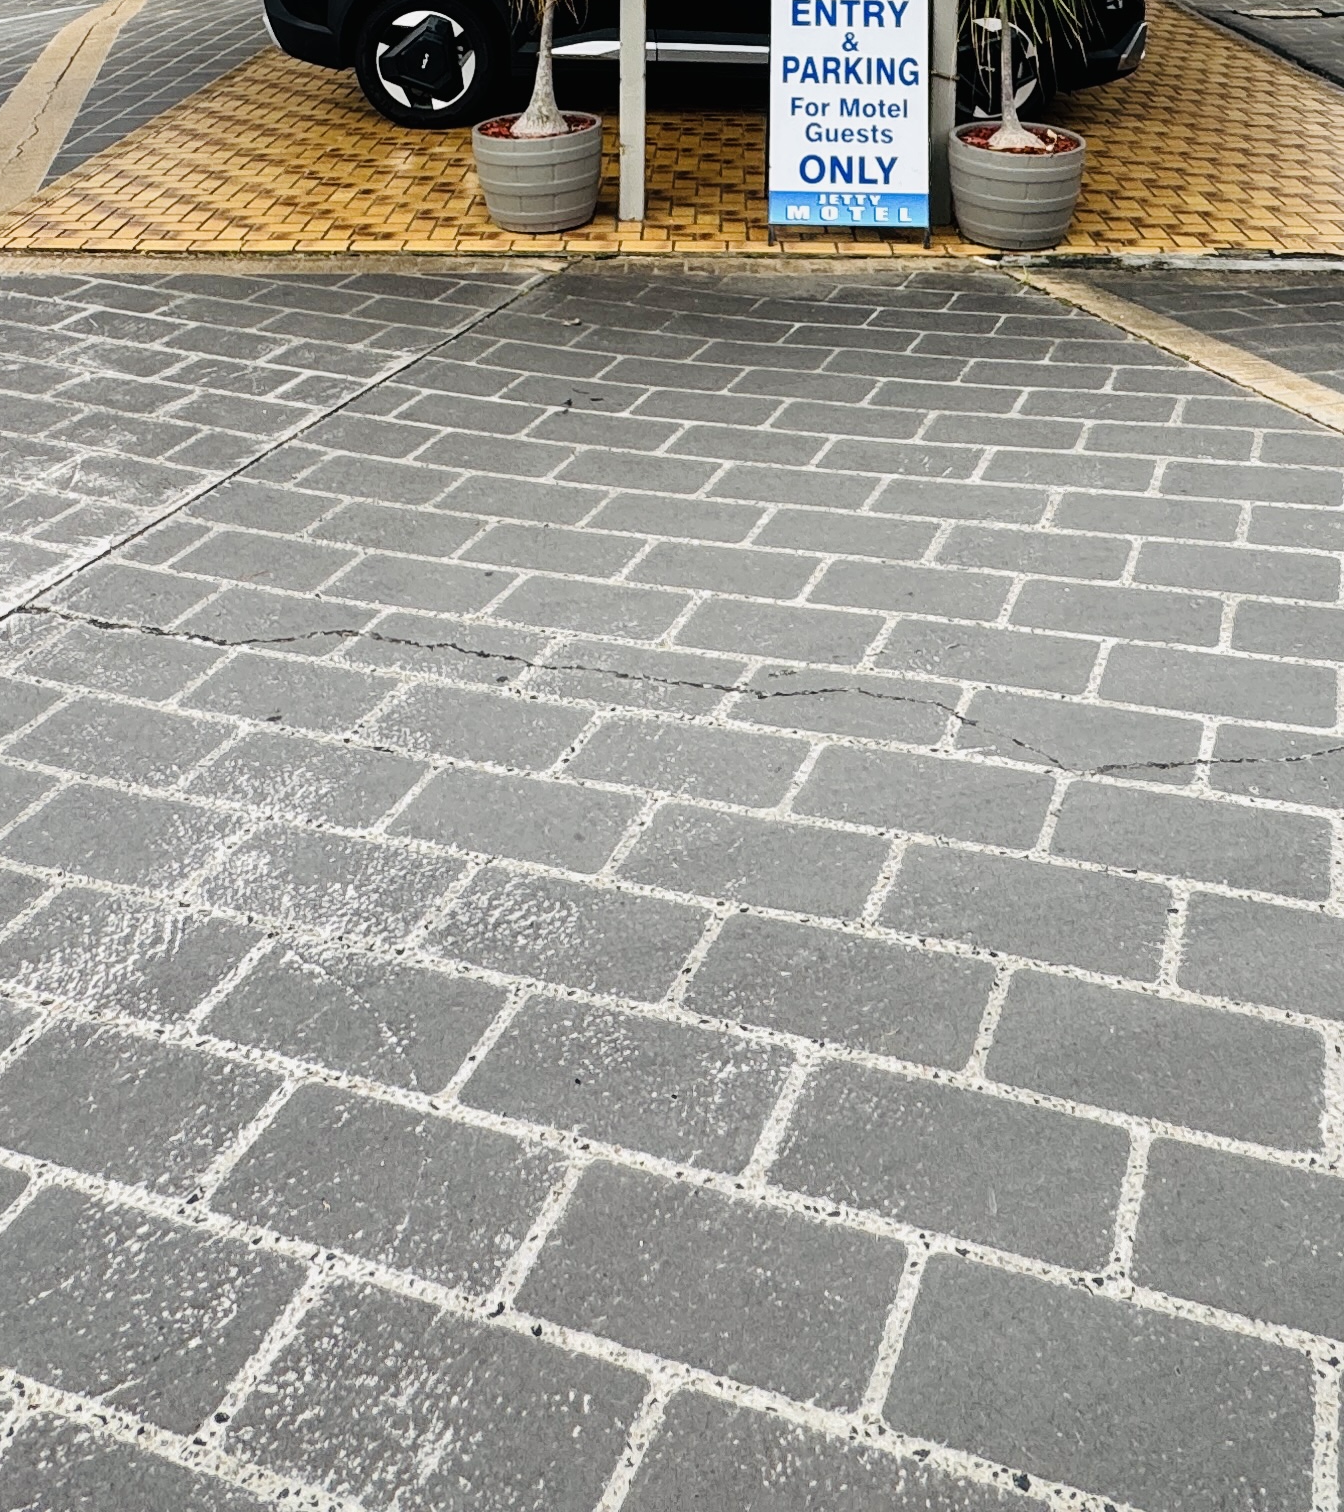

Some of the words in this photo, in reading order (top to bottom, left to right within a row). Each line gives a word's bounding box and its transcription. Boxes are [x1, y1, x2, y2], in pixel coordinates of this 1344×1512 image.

[791, 0, 910, 28] ENTRY
[841, 31, 859, 52] &
[782, 55, 920, 86] PARKING
[790, 96, 830, 117] For
[839, 97, 908, 119] Motel
[805, 122, 894, 144] Guests
[799, 154, 899, 185] ONLY
[817, 193, 882, 206] JETTY
[785, 205, 913, 223] MOTEL
